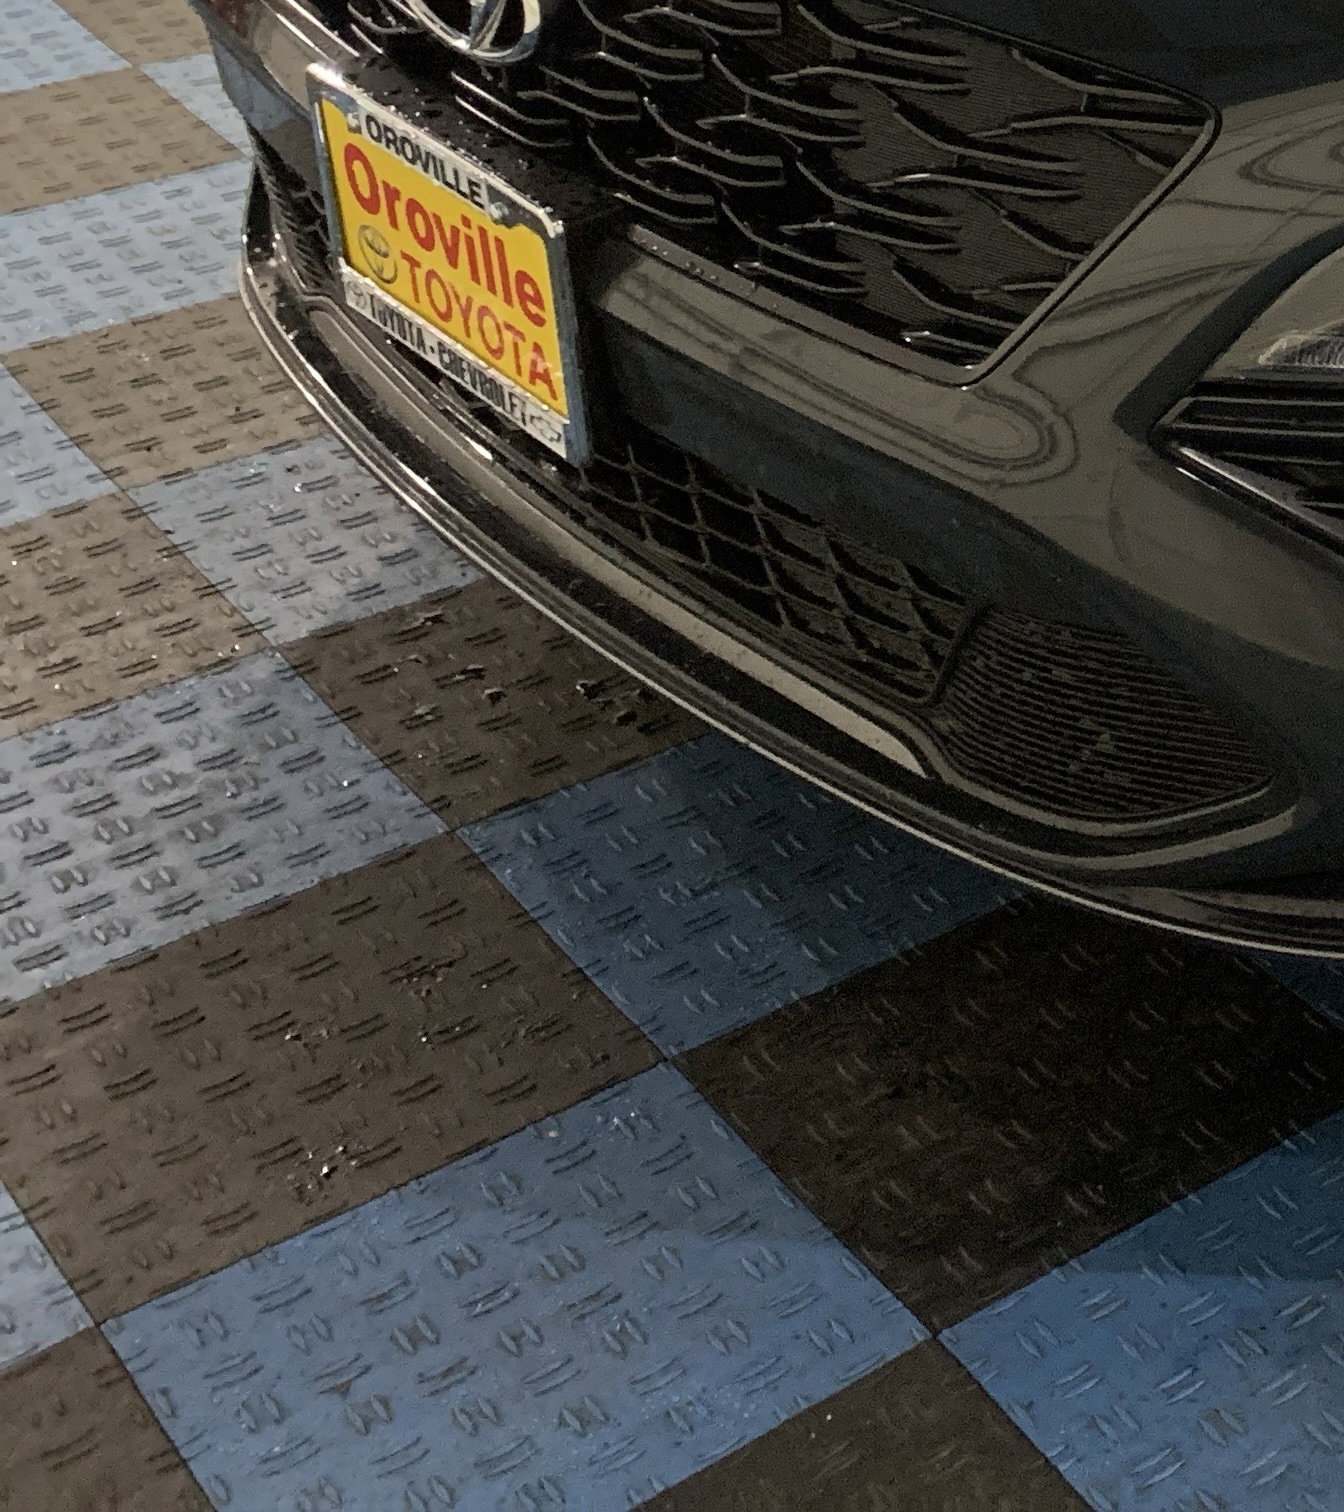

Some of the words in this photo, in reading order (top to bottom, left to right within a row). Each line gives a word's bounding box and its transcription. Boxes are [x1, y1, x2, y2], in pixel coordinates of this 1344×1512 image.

[344, 143, 547, 327] Oroville
[366, 115, 486, 209] OROVILLE
[401, 250, 558, 400] TOYOTA
